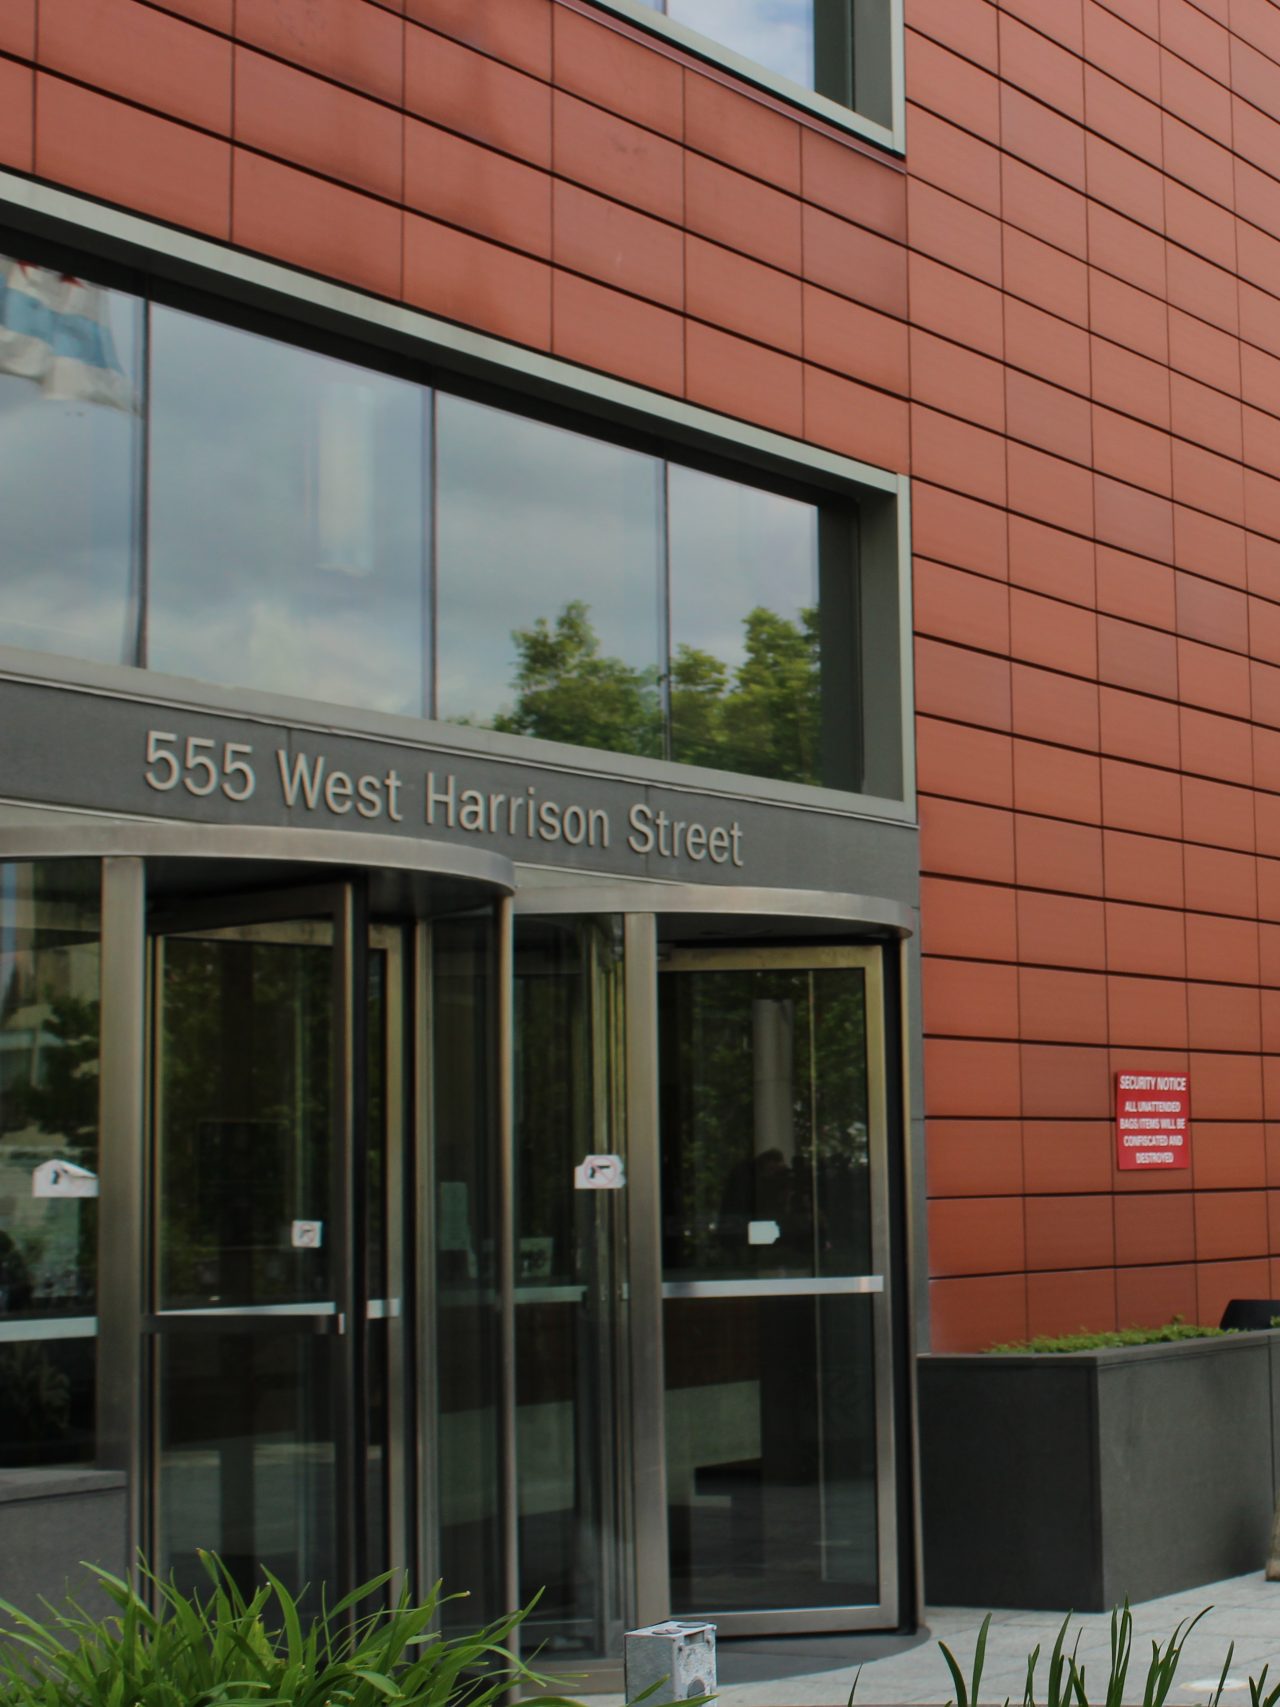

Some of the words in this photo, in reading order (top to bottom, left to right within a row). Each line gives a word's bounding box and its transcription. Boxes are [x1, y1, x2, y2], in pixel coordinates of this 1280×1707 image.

[143, 729, 257, 801] 555
[276, 747, 404, 823] West
[425, 771, 609, 849] Harrison
[627, 803, 745, 868] Street
[1120, 1075, 1157, 1091] SECURITY
[1157, 1076, 1187, 1092] NOTICE
[1125, 1101, 1137, 1113] ALL
